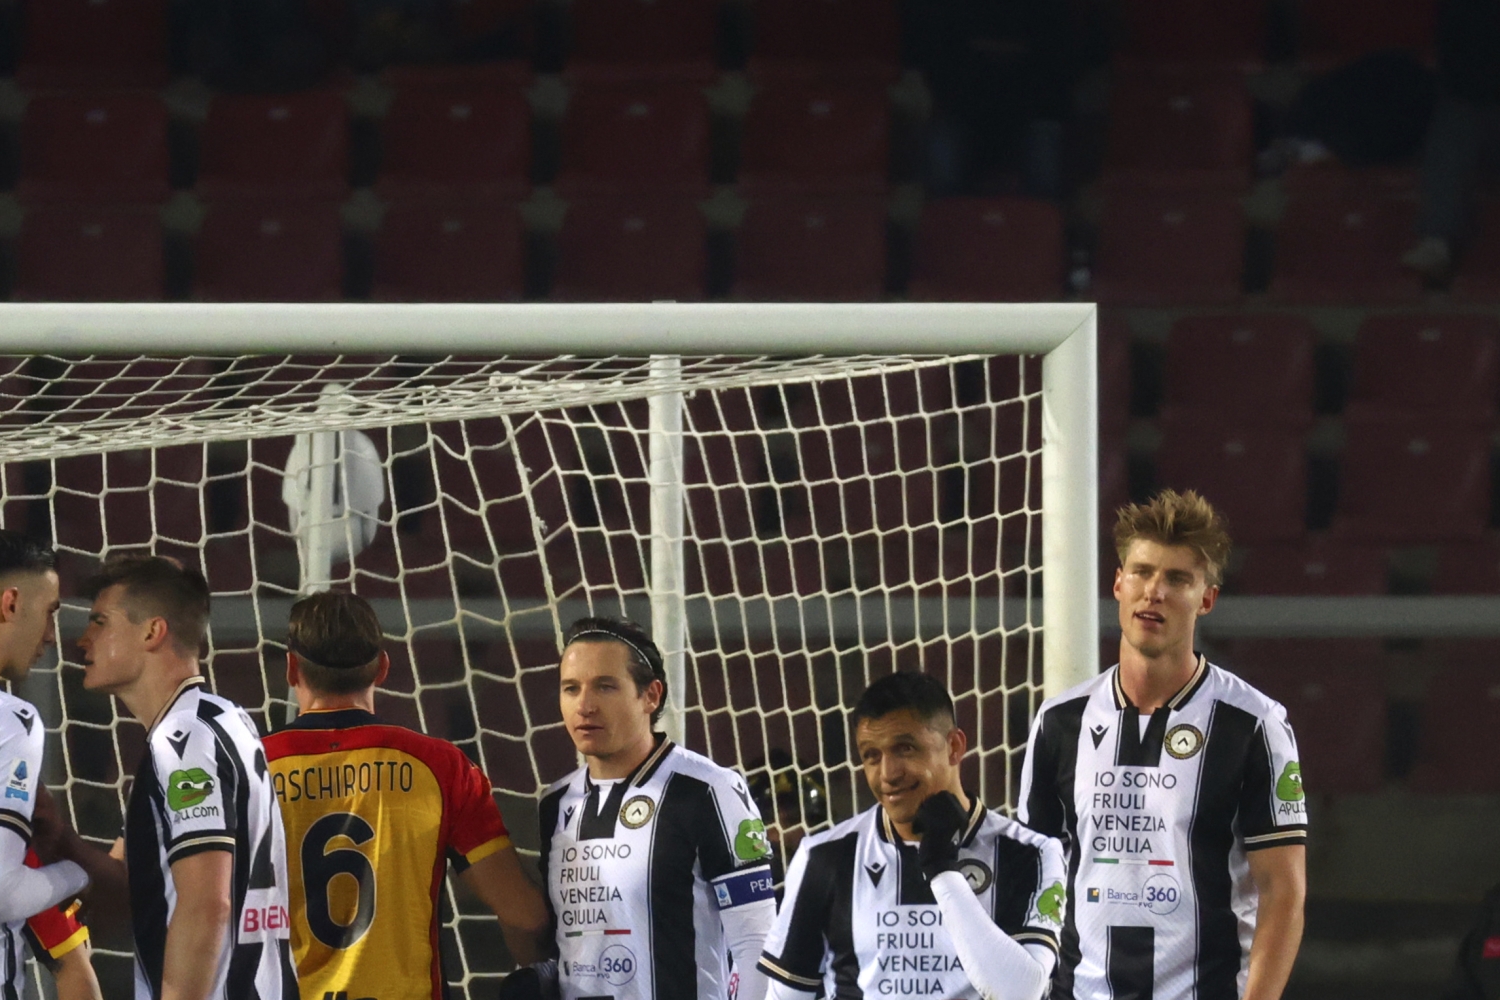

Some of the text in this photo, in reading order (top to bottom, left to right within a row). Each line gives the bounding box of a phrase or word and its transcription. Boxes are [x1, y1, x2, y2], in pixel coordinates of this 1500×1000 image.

[273, 761, 413, 802] ASCHIROTTO
[1094, 771, 1177, 789] IO SONO
[1092, 793, 1146, 810] FRIULI
[1092, 814, 1167, 832] VENEZIA
[561, 843, 631, 863] IO SONO
[1092, 836, 1153, 853] GIULIA
[301, 812, 378, 951] 6
[560, 865, 600, 884] FRIULI
[560, 886, 622, 904] VENEZIA
[1107, 886, 1177, 903] Banca 360
[562, 908, 608, 926] GIULIA
[876, 910, 943, 927] IO SO
[876, 932, 934, 949] FRIULI
[604, 957, 633, 974] 360
[877, 954, 965, 972] VENEZIA
[877, 978, 945, 995] GIULIA
